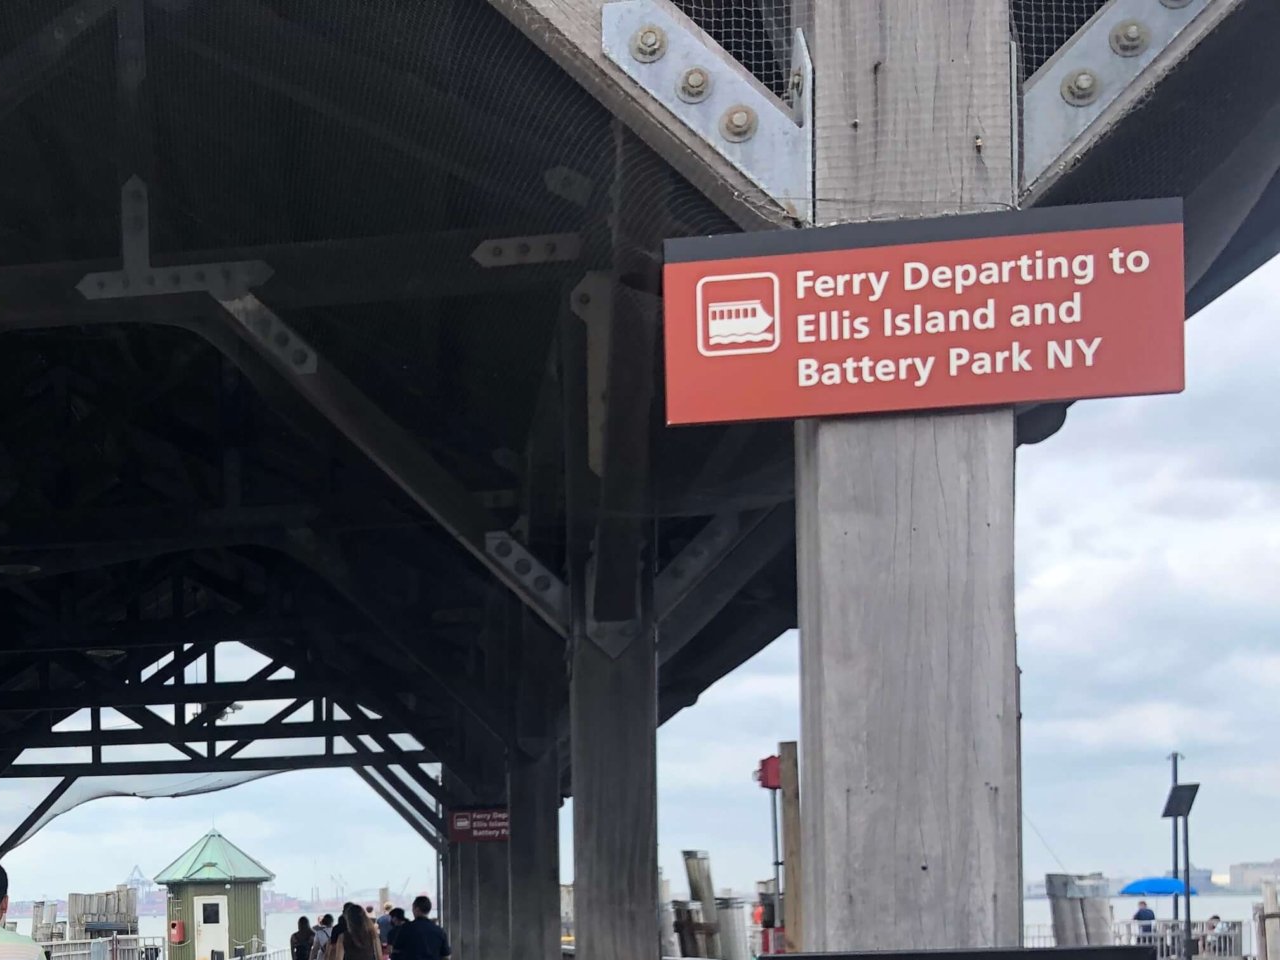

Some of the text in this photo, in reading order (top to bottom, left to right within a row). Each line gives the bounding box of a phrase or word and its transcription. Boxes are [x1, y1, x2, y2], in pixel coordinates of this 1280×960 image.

[795, 247, 1150, 302] Ferry Departing to
[796, 292, 1081, 343] Ellis Island and
[797, 337, 1102, 388] Battery Park NY
